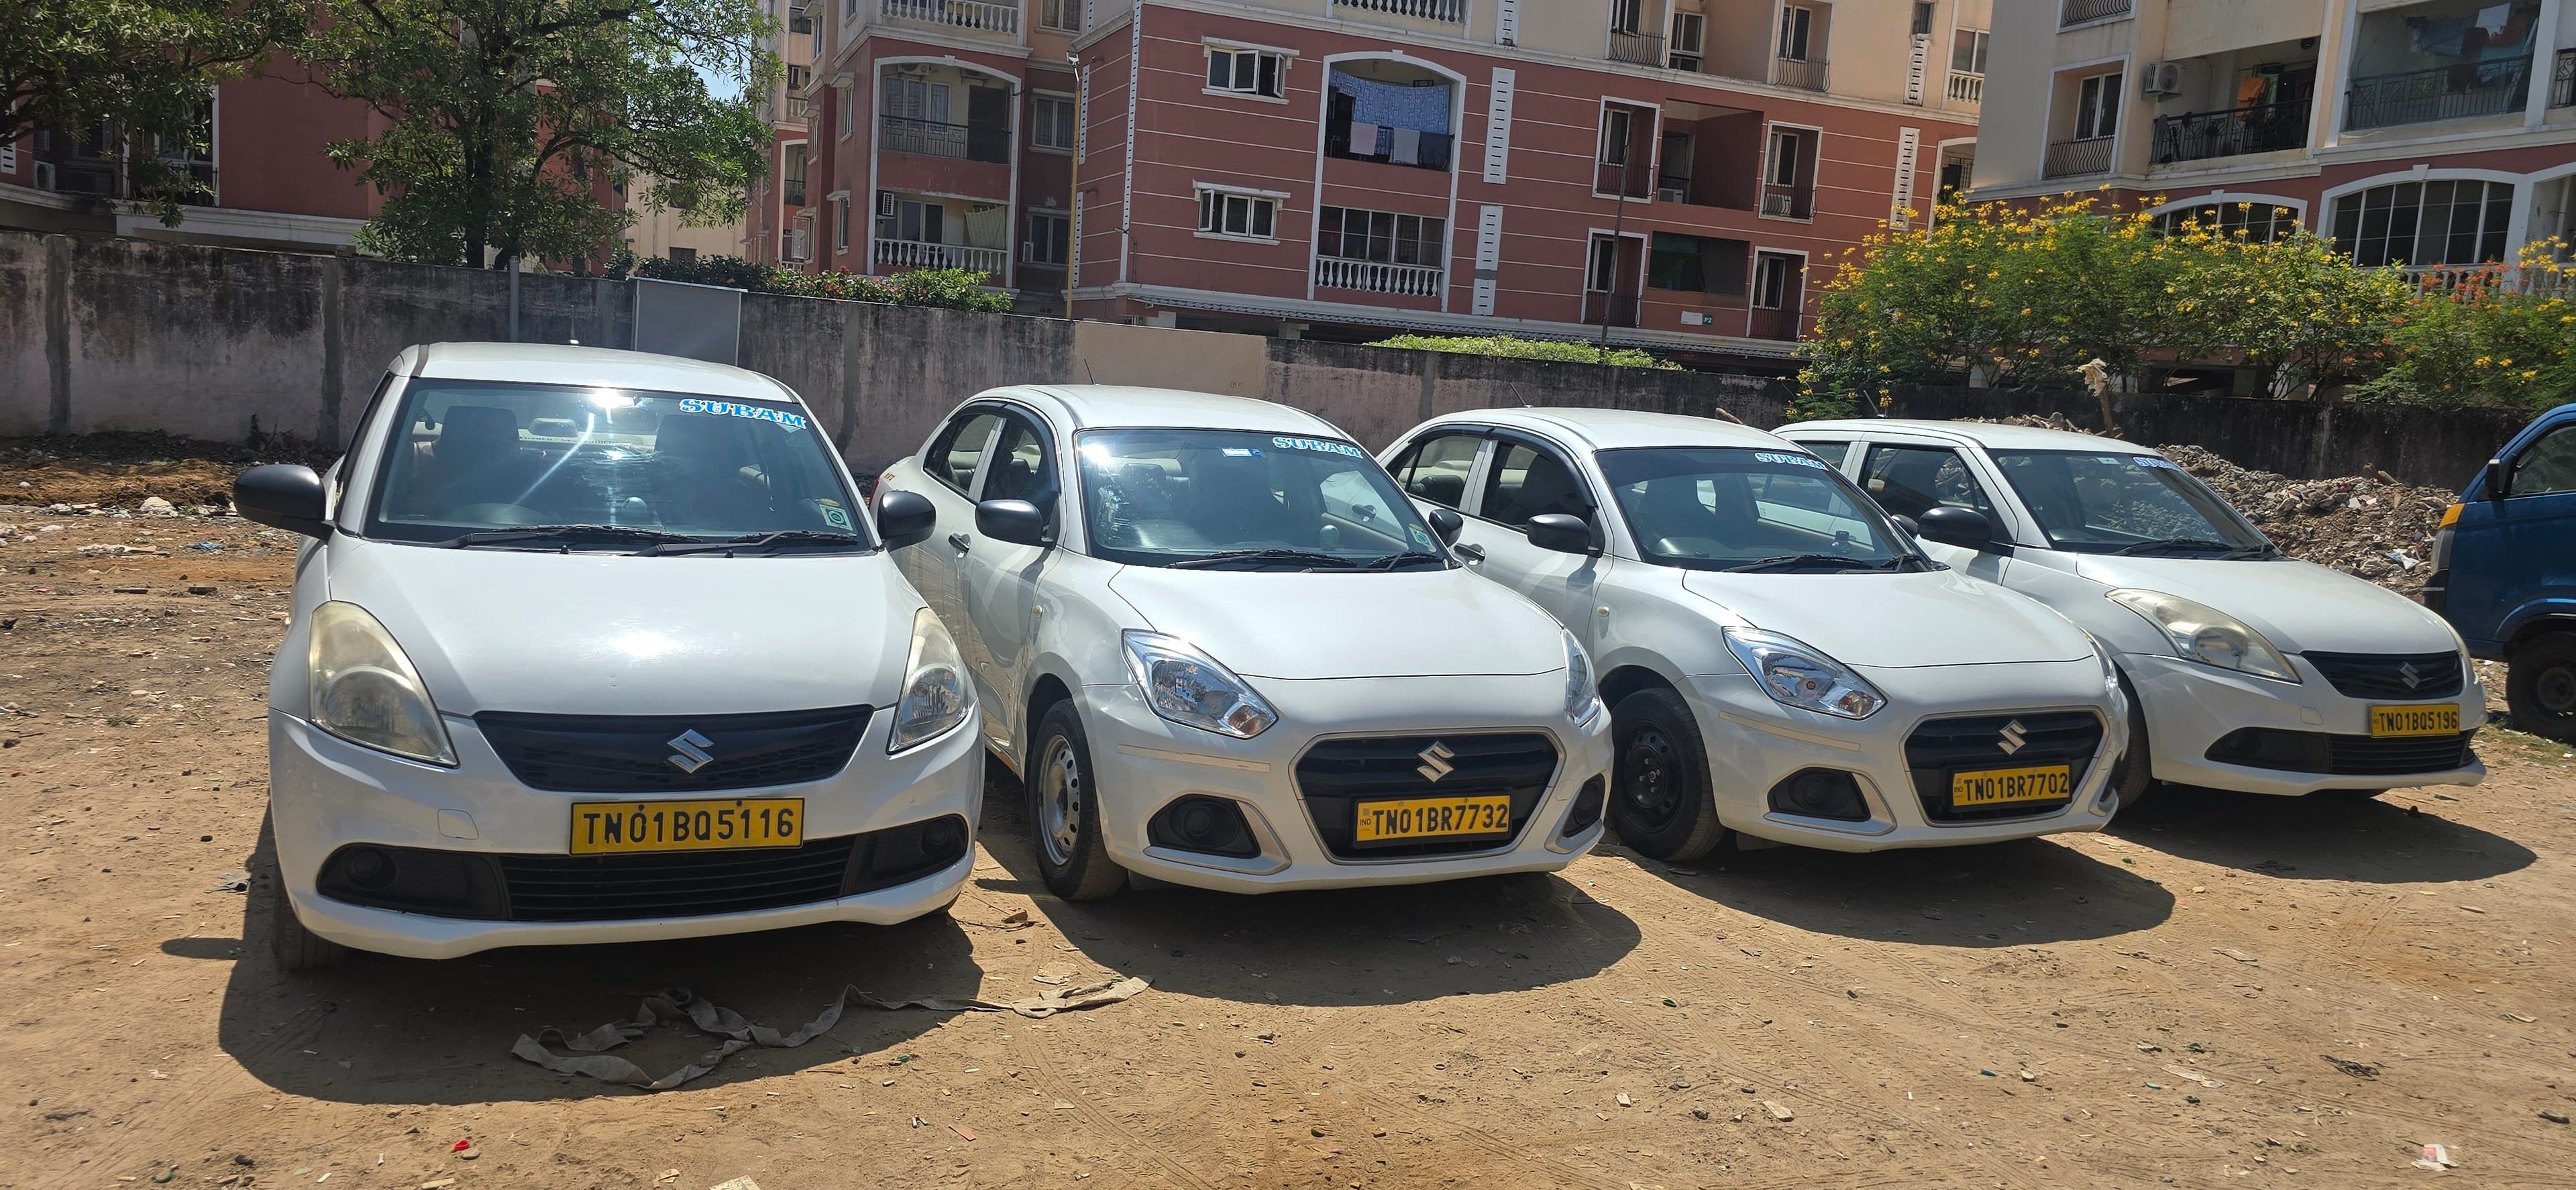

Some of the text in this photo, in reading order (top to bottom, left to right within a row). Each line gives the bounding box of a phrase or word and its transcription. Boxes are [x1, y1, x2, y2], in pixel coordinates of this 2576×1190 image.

[680, 398, 806, 429] SUBAM
[1273, 437, 1363, 459] SUBAM
[1755, 453, 1829, 471] SUBAM
[2379, 711, 2458, 732] TN01BQ5196
[1964, 772, 2068, 802] TN01BR7702
[583, 808, 794, 845] TN01BQ5116
[1359, 818, 1372, 826] IND
[1373, 804, 1509, 836] TN01BR7732
